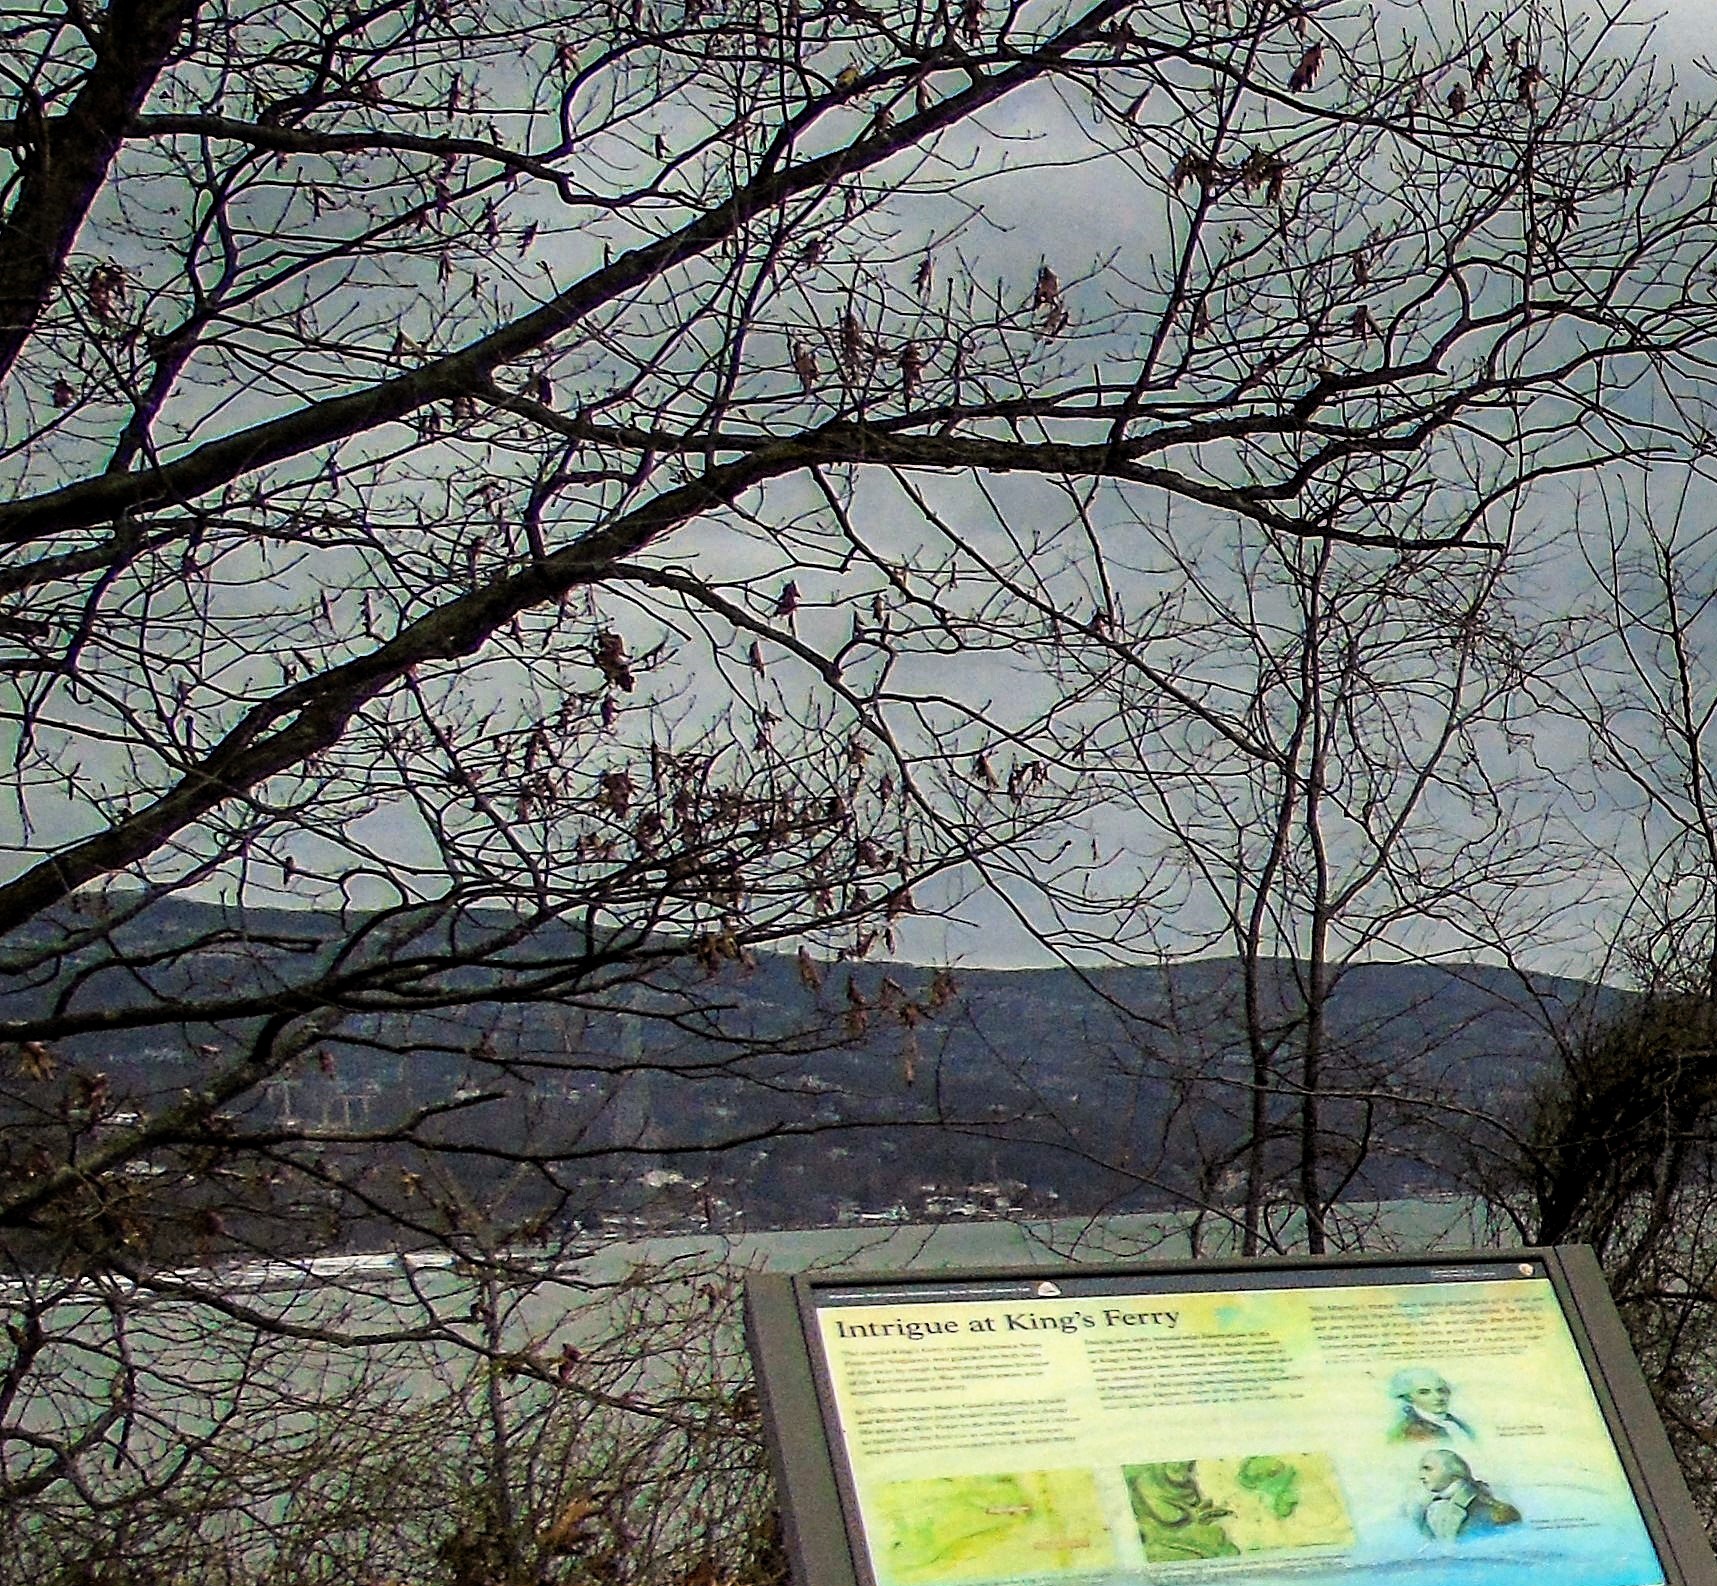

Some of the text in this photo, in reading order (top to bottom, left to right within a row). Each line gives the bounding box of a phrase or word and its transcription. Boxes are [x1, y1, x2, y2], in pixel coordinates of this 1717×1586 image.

[836, 1309, 1180, 1341] Intrigue at King's Ferry
